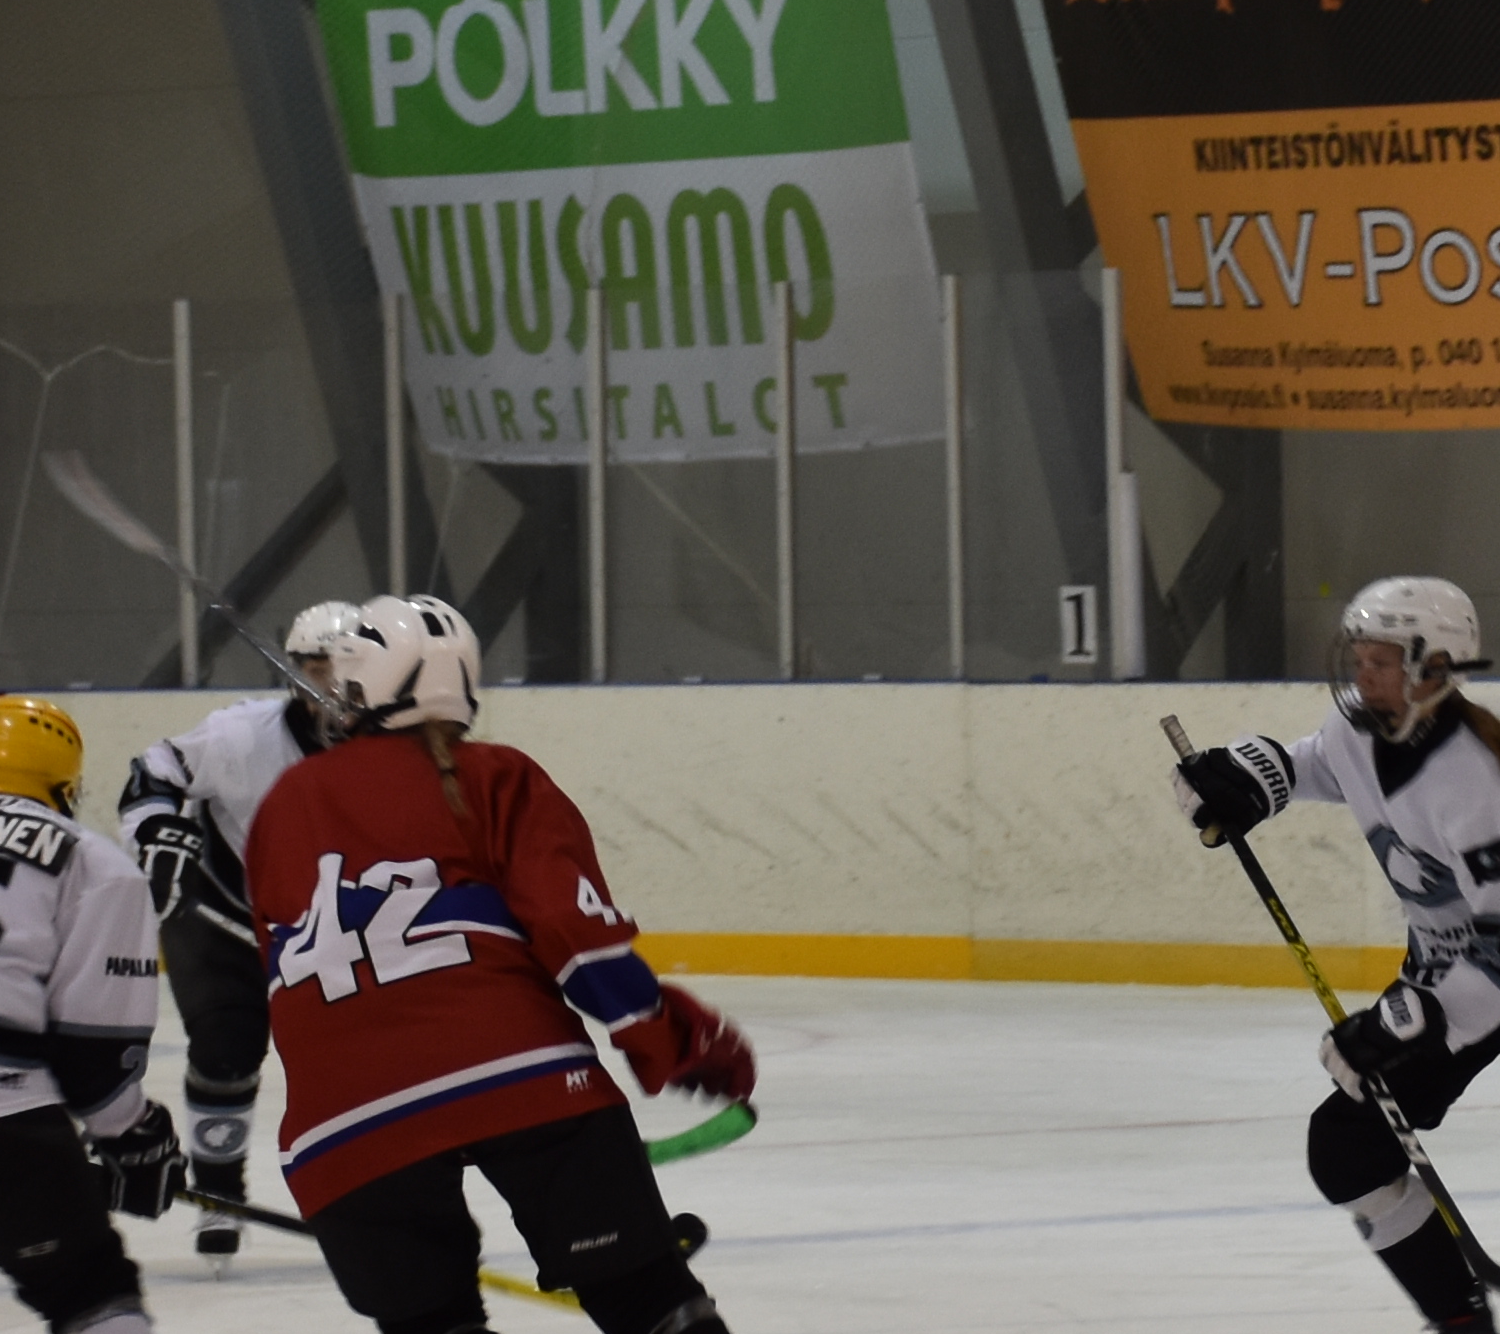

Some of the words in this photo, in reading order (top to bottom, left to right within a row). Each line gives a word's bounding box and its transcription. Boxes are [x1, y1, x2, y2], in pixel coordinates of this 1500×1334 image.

[391, 182, 836, 357] KUUSAMO
[1438, 338, 1482, 365] 040
[1065, 592, 1092, 656] 1
[278, 852, 473, 1004] 42
[576, 875, 633, 926] 4
